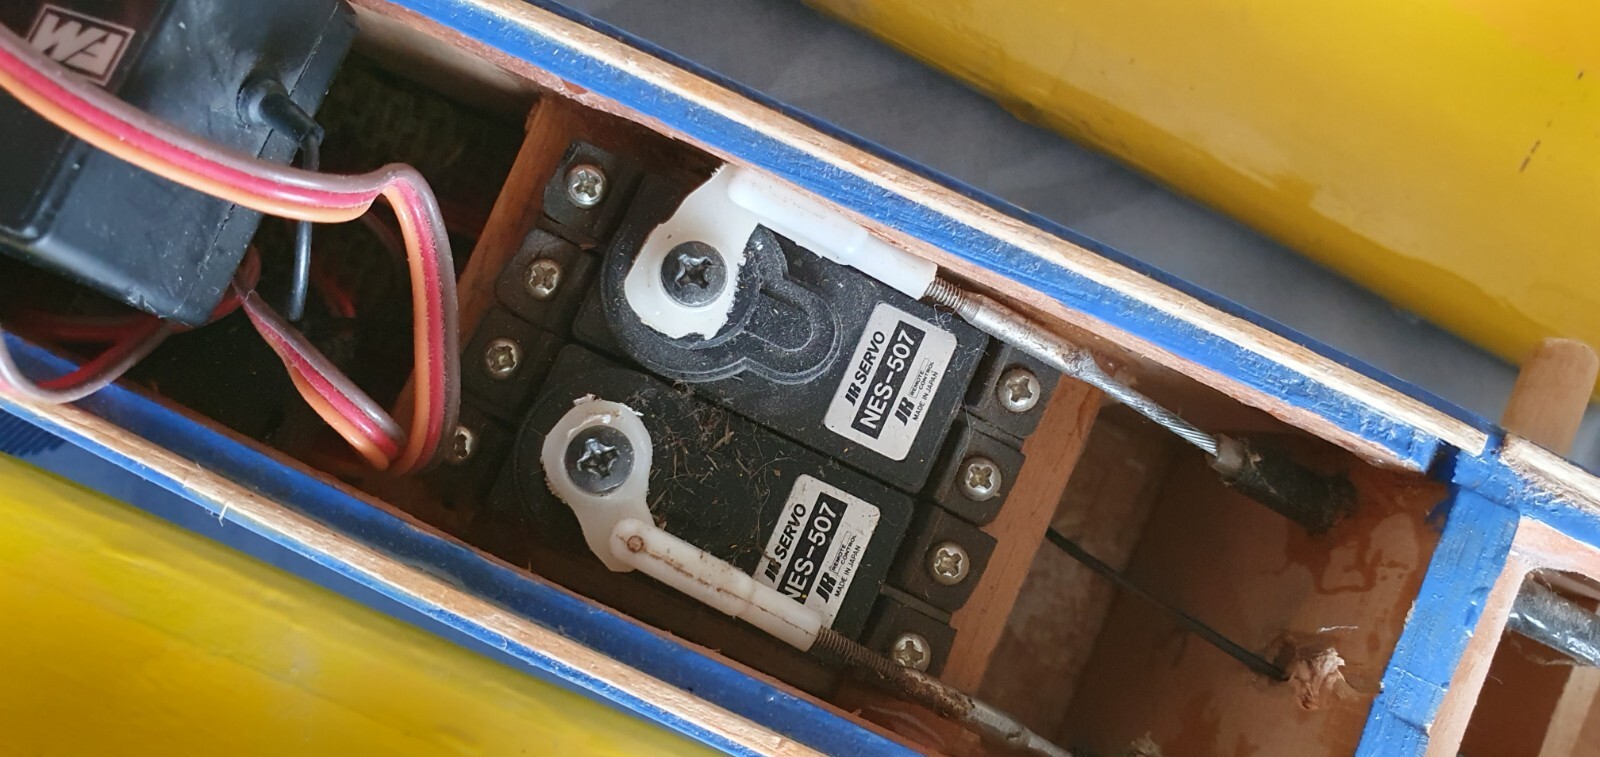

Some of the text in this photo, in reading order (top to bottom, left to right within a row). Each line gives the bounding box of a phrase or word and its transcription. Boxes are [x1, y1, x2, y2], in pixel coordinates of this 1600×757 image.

[855, 330, 886, 384] SERVO
[859, 329, 915, 429] NES-507
[910, 370, 925, 396] REMOTE
[919, 361, 935, 390] CONTROL
[894, 396, 915, 426] JR
[912, 371, 939, 421] MADE IN JAPAN
[774, 503, 807, 560] SERVO
[832, 544, 847, 571] REMOTE
[840, 534, 857, 565] CONTROL
[834, 545, 862, 598] MADE IN JAPAN
[816, 572, 837, 603] JR
